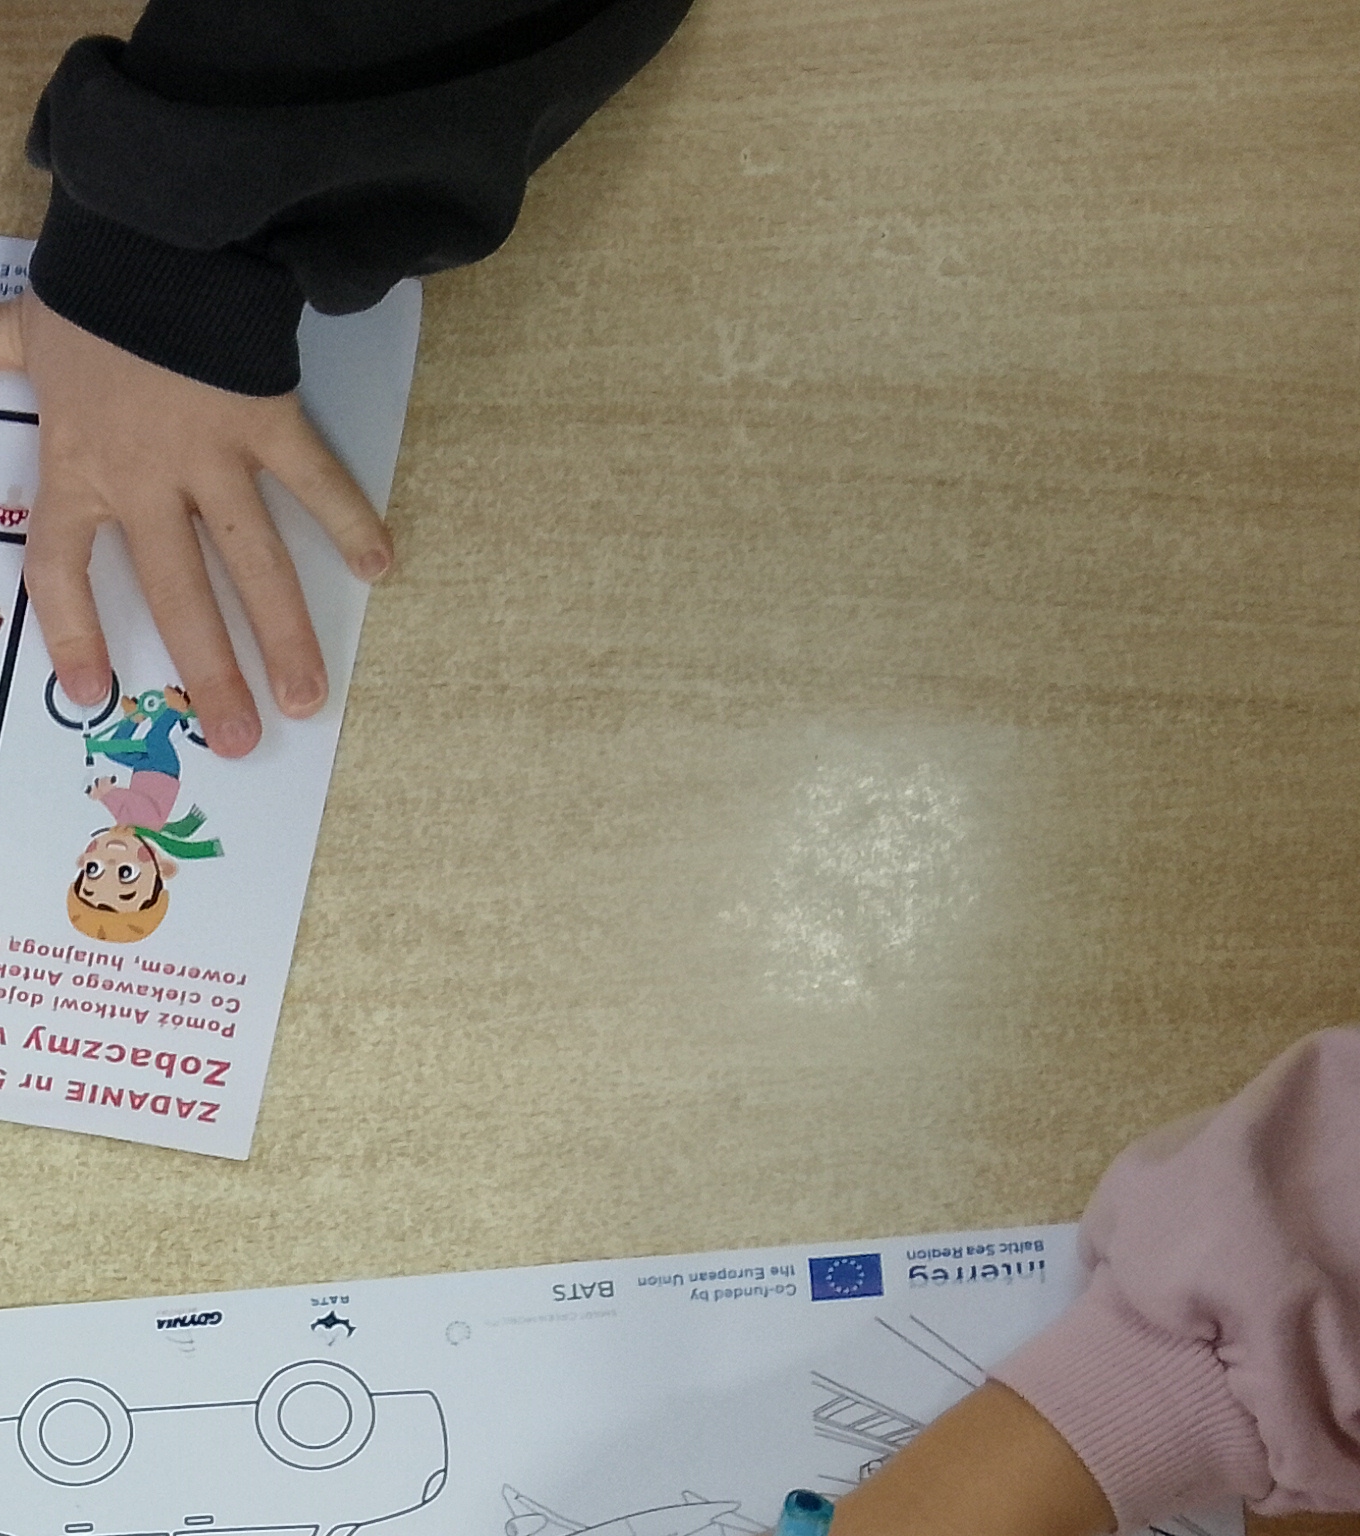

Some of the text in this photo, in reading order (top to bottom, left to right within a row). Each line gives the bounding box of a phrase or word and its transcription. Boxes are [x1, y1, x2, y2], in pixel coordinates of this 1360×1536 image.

[7, 935, 125, 973] hulajnogą
[133, 954, 248, 987] rowerem,
[71, 972, 202, 1007] ciekawego
[52, 995, 151, 1026] Antkowi
[210, 994, 242, 1015] Co
[157, 1011, 237, 1039] Pomóż
[21, 1024, 232, 1088] Zobaczmy
[17, 1072, 54, 1093] nr
[64, 1079, 222, 1124] ZADANIE
[965, 1238, 1046, 1258] Baltic Sea
[636, 1263, 797, 1288] the European Union
[907, 1256, 1047, 1293] Interreg
[551, 1279, 616, 1303] BATS
[689, 1282, 798, 1303] Co-funded by
[155, 1310, 224, 1331] GDYNIA
